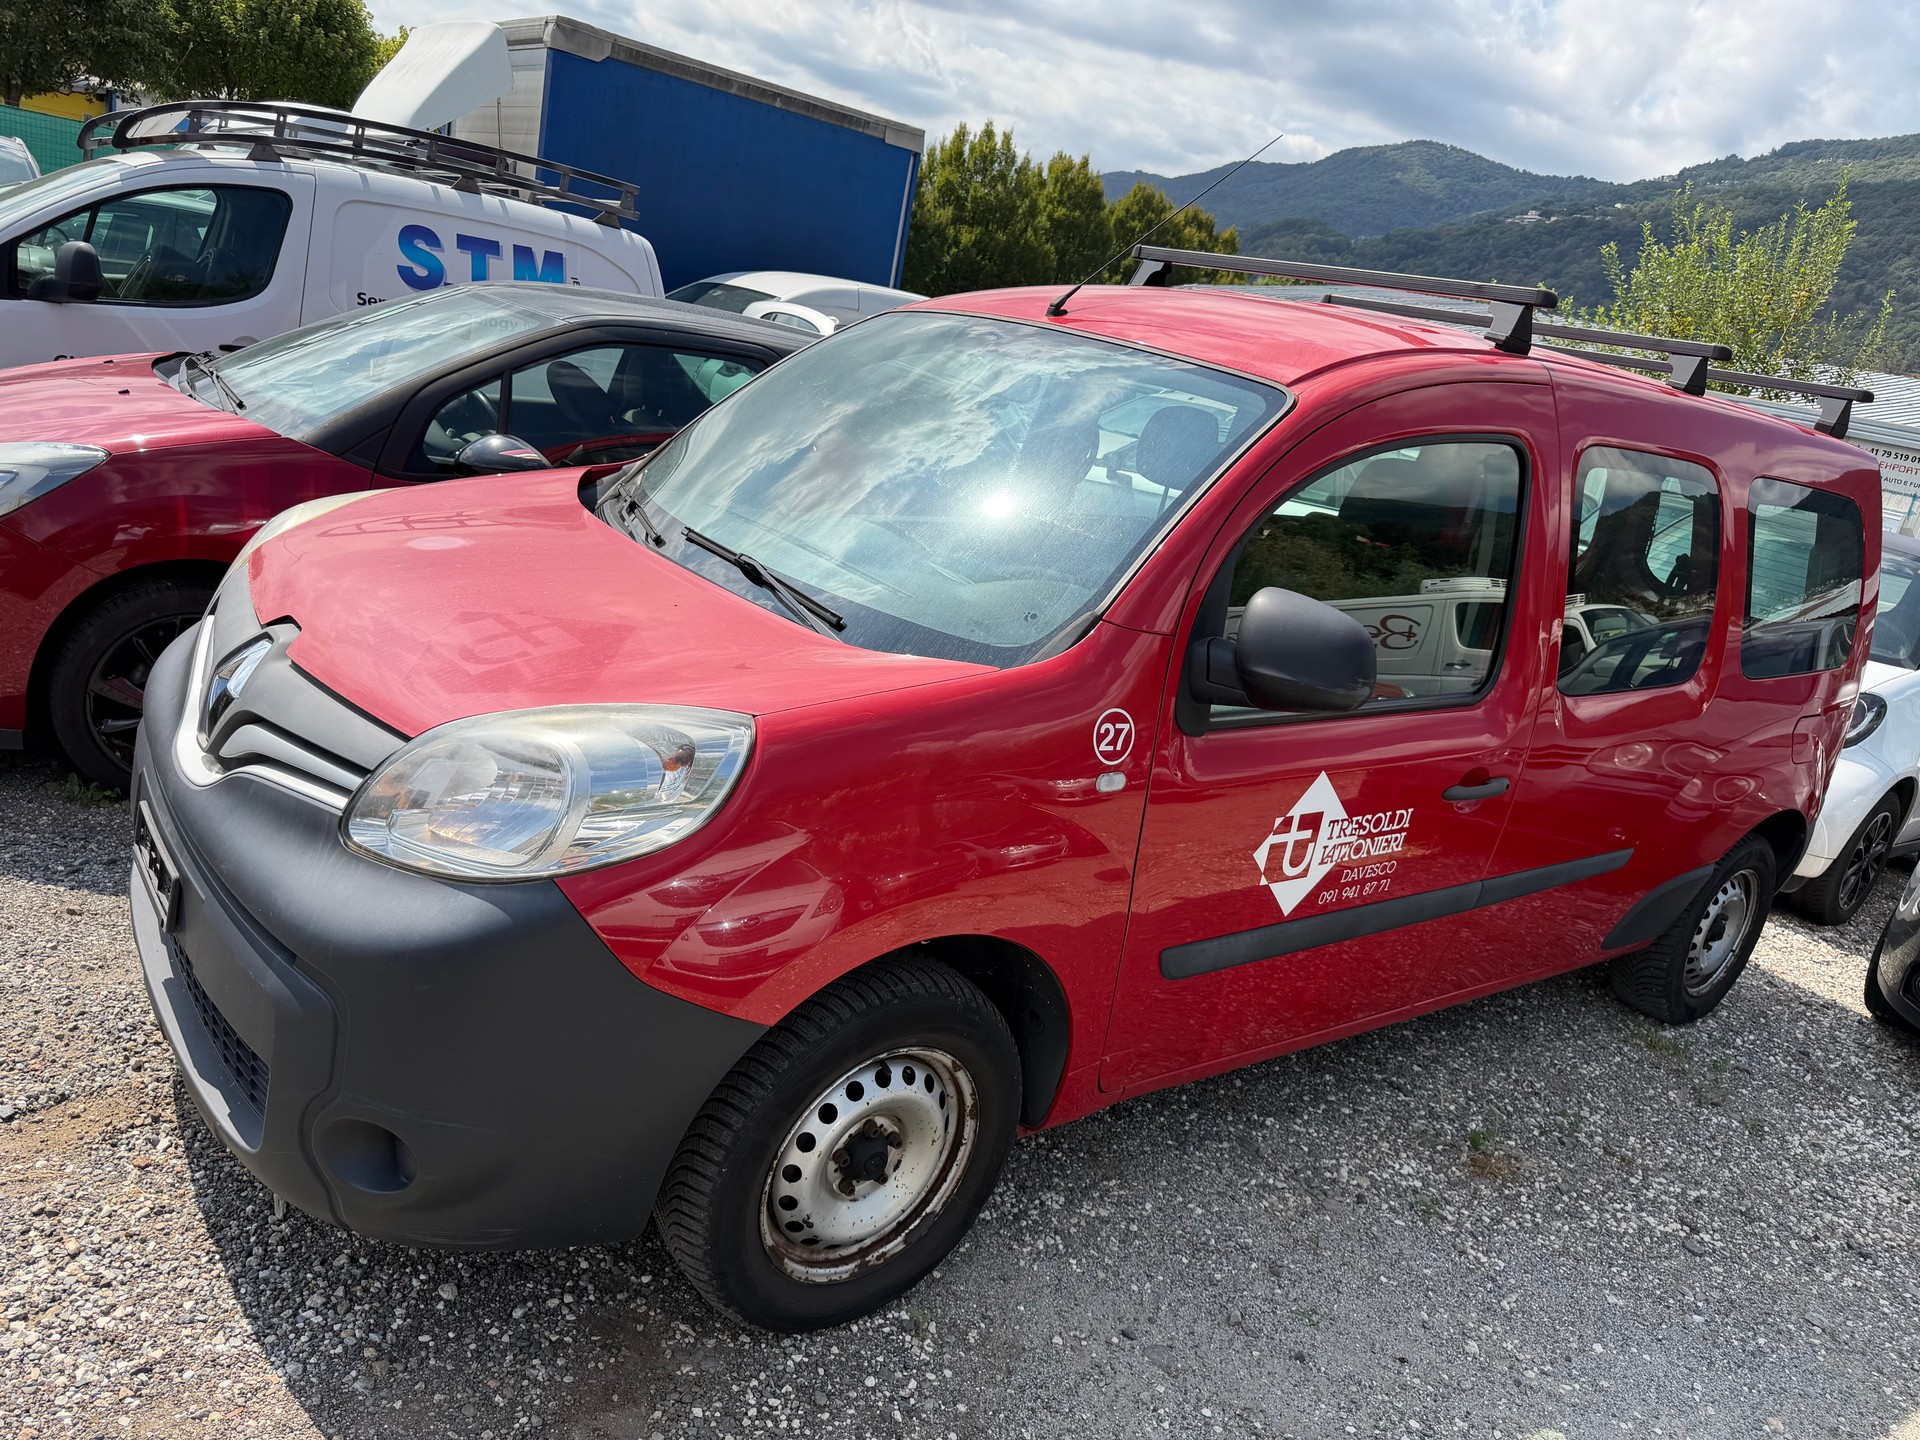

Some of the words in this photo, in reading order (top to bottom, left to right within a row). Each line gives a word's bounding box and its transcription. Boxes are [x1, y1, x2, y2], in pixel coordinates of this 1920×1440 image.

[1881, 449, 1892, 458] 79
[1893, 452, 1909, 462] 519
[1883, 476, 1902, 485] AUTO
[1099, 722, 1130, 751] 27
[1327, 808, 1413, 840] TRESOLDI
[1340, 860, 1397, 883] DAVESCO
[1318, 889, 1338, 904] 091
[1342, 885, 1360, 900] 941
[1362, 881, 1377, 896] 87
[1378, 879, 1391, 893] 71
